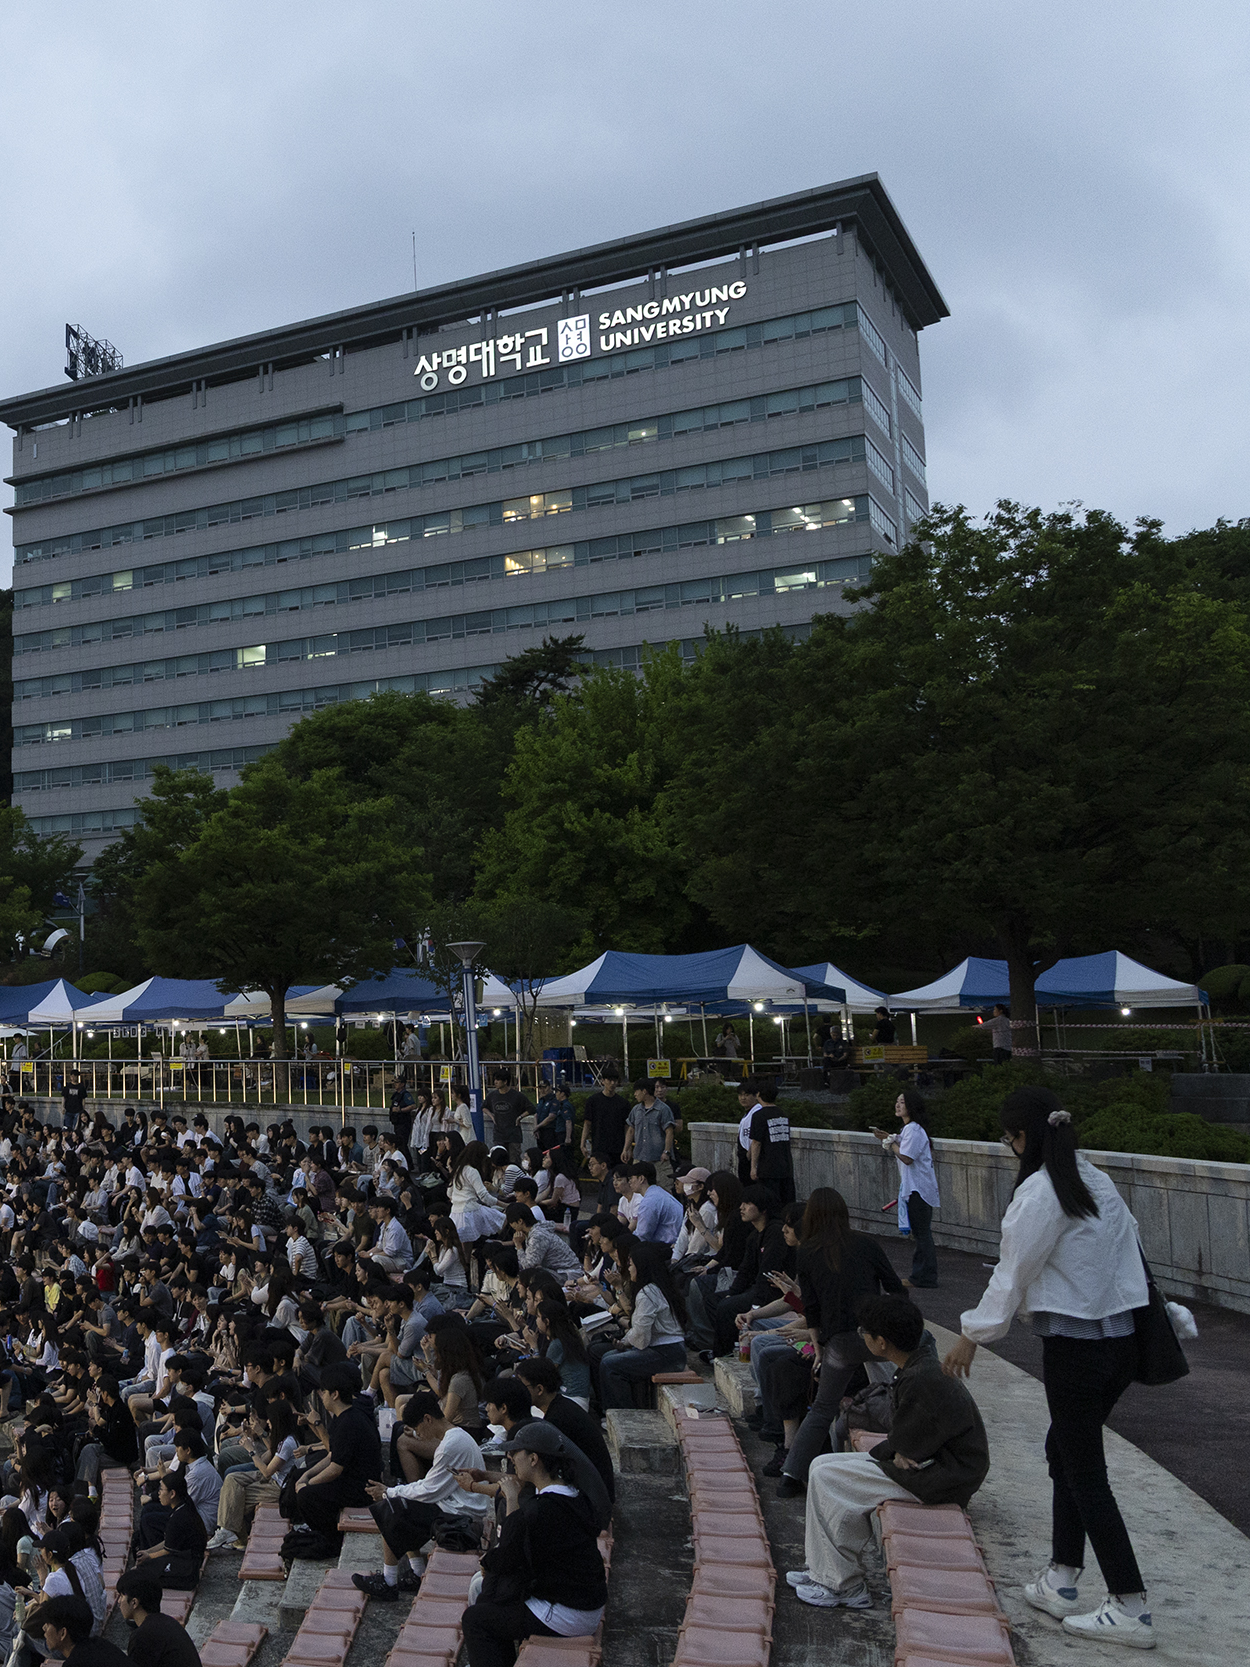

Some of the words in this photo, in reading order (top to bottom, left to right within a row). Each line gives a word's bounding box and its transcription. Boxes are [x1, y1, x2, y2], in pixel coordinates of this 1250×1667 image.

[598, 280, 747, 330] SANGMYUNG
[599, 307, 730, 352] UNIVERSITY
[413, 327, 551, 391] 상명대학교
